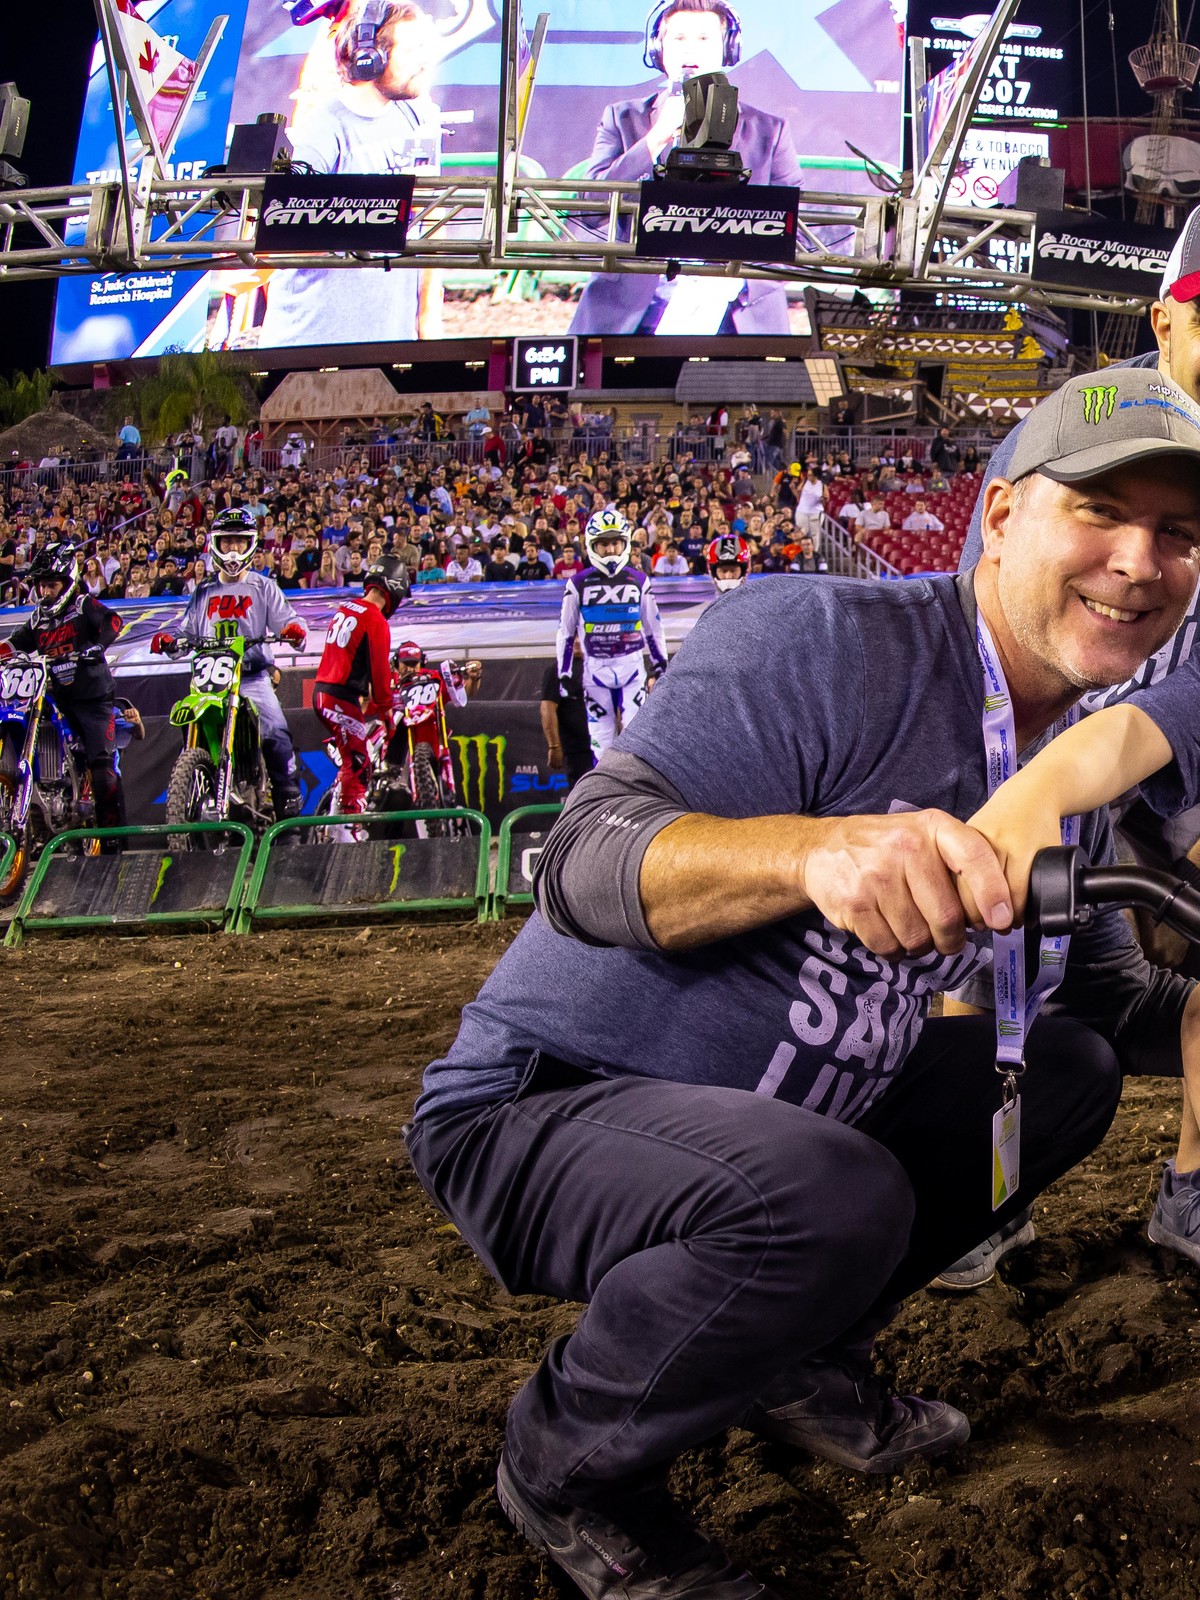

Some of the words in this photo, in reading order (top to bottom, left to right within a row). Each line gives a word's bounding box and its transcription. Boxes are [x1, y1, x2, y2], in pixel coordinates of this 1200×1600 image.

[999, 44, 1022, 55] FAN
[1024, 46, 1064, 59] ISSUES
[1013, 107, 1058, 120] LOCATION
[990, 141, 1044, 156] TOBACCO
[983, 159, 1017, 171] VENU
[286, 197, 329, 208] ROCKY
[329, 197, 400, 208] MOUNTAIN
[665, 205, 712, 217] ROCKY
[712, 206, 786, 220] MOUNTAIN
[1059, 233, 1102, 249] ROCKY
[1102, 240, 1171, 260] MOUNTAIN
[89, 290, 130, 305] Research
[131, 286, 172, 302] Hospital
[103, 279, 125, 294] Jude
[530, 367, 560, 384] PM
[582, 584, 640, 606] FXR
[207, 595, 253, 620] FOX
[326, 612, 358, 648] 38
[193, 656, 234, 687] 36
[405, 683, 440, 710] 38
[515, 765, 538, 774] AMA
[216, 768, 226, 812] DUNLOP
[1009, 949, 1017, 1020] SUPERCROSS
[579, 1530, 615, 1566] Reebok
